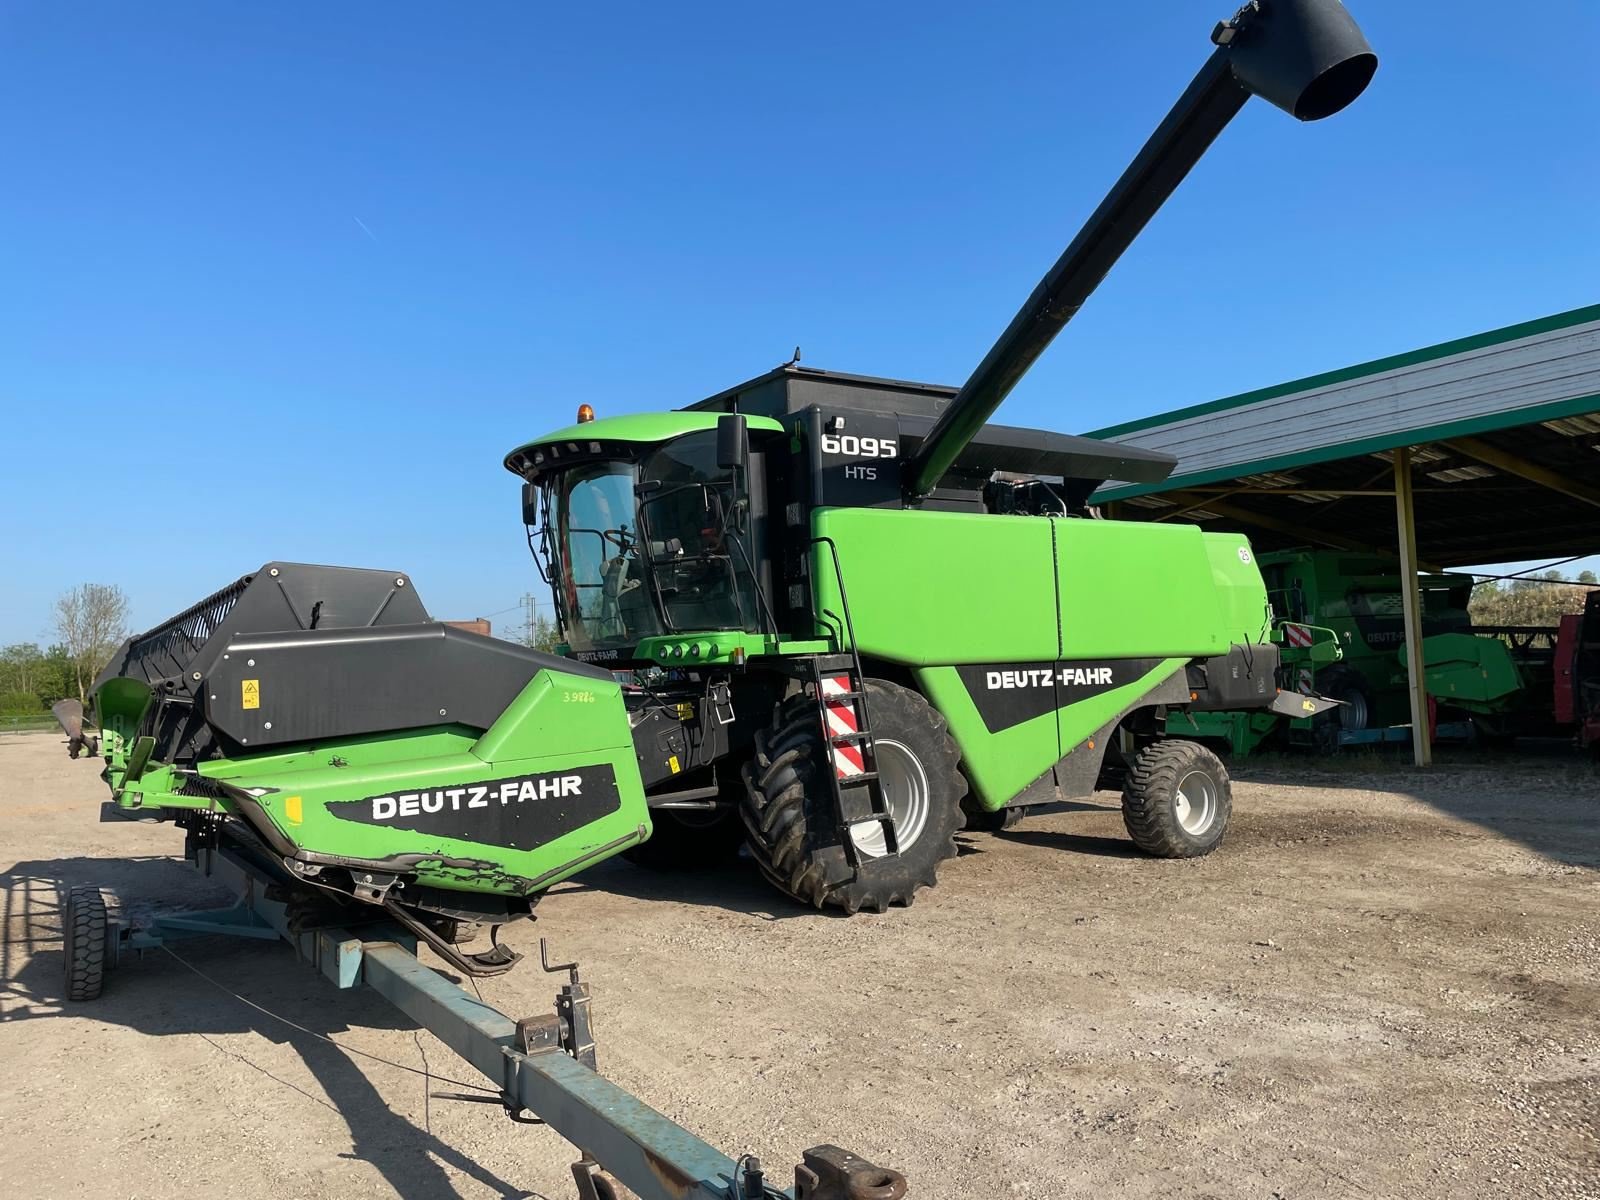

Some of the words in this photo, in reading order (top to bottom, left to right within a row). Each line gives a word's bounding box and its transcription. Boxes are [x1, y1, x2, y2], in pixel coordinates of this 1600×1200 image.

[821, 433, 897, 459] 6095
[845, 465, 877, 480] HTS
[577, 649, 618, 661] DEUTZ-FAHR
[986, 667, 1113, 690] DEUTZ-FAHR
[372, 775, 583, 820] DEUTZ-FAHR
